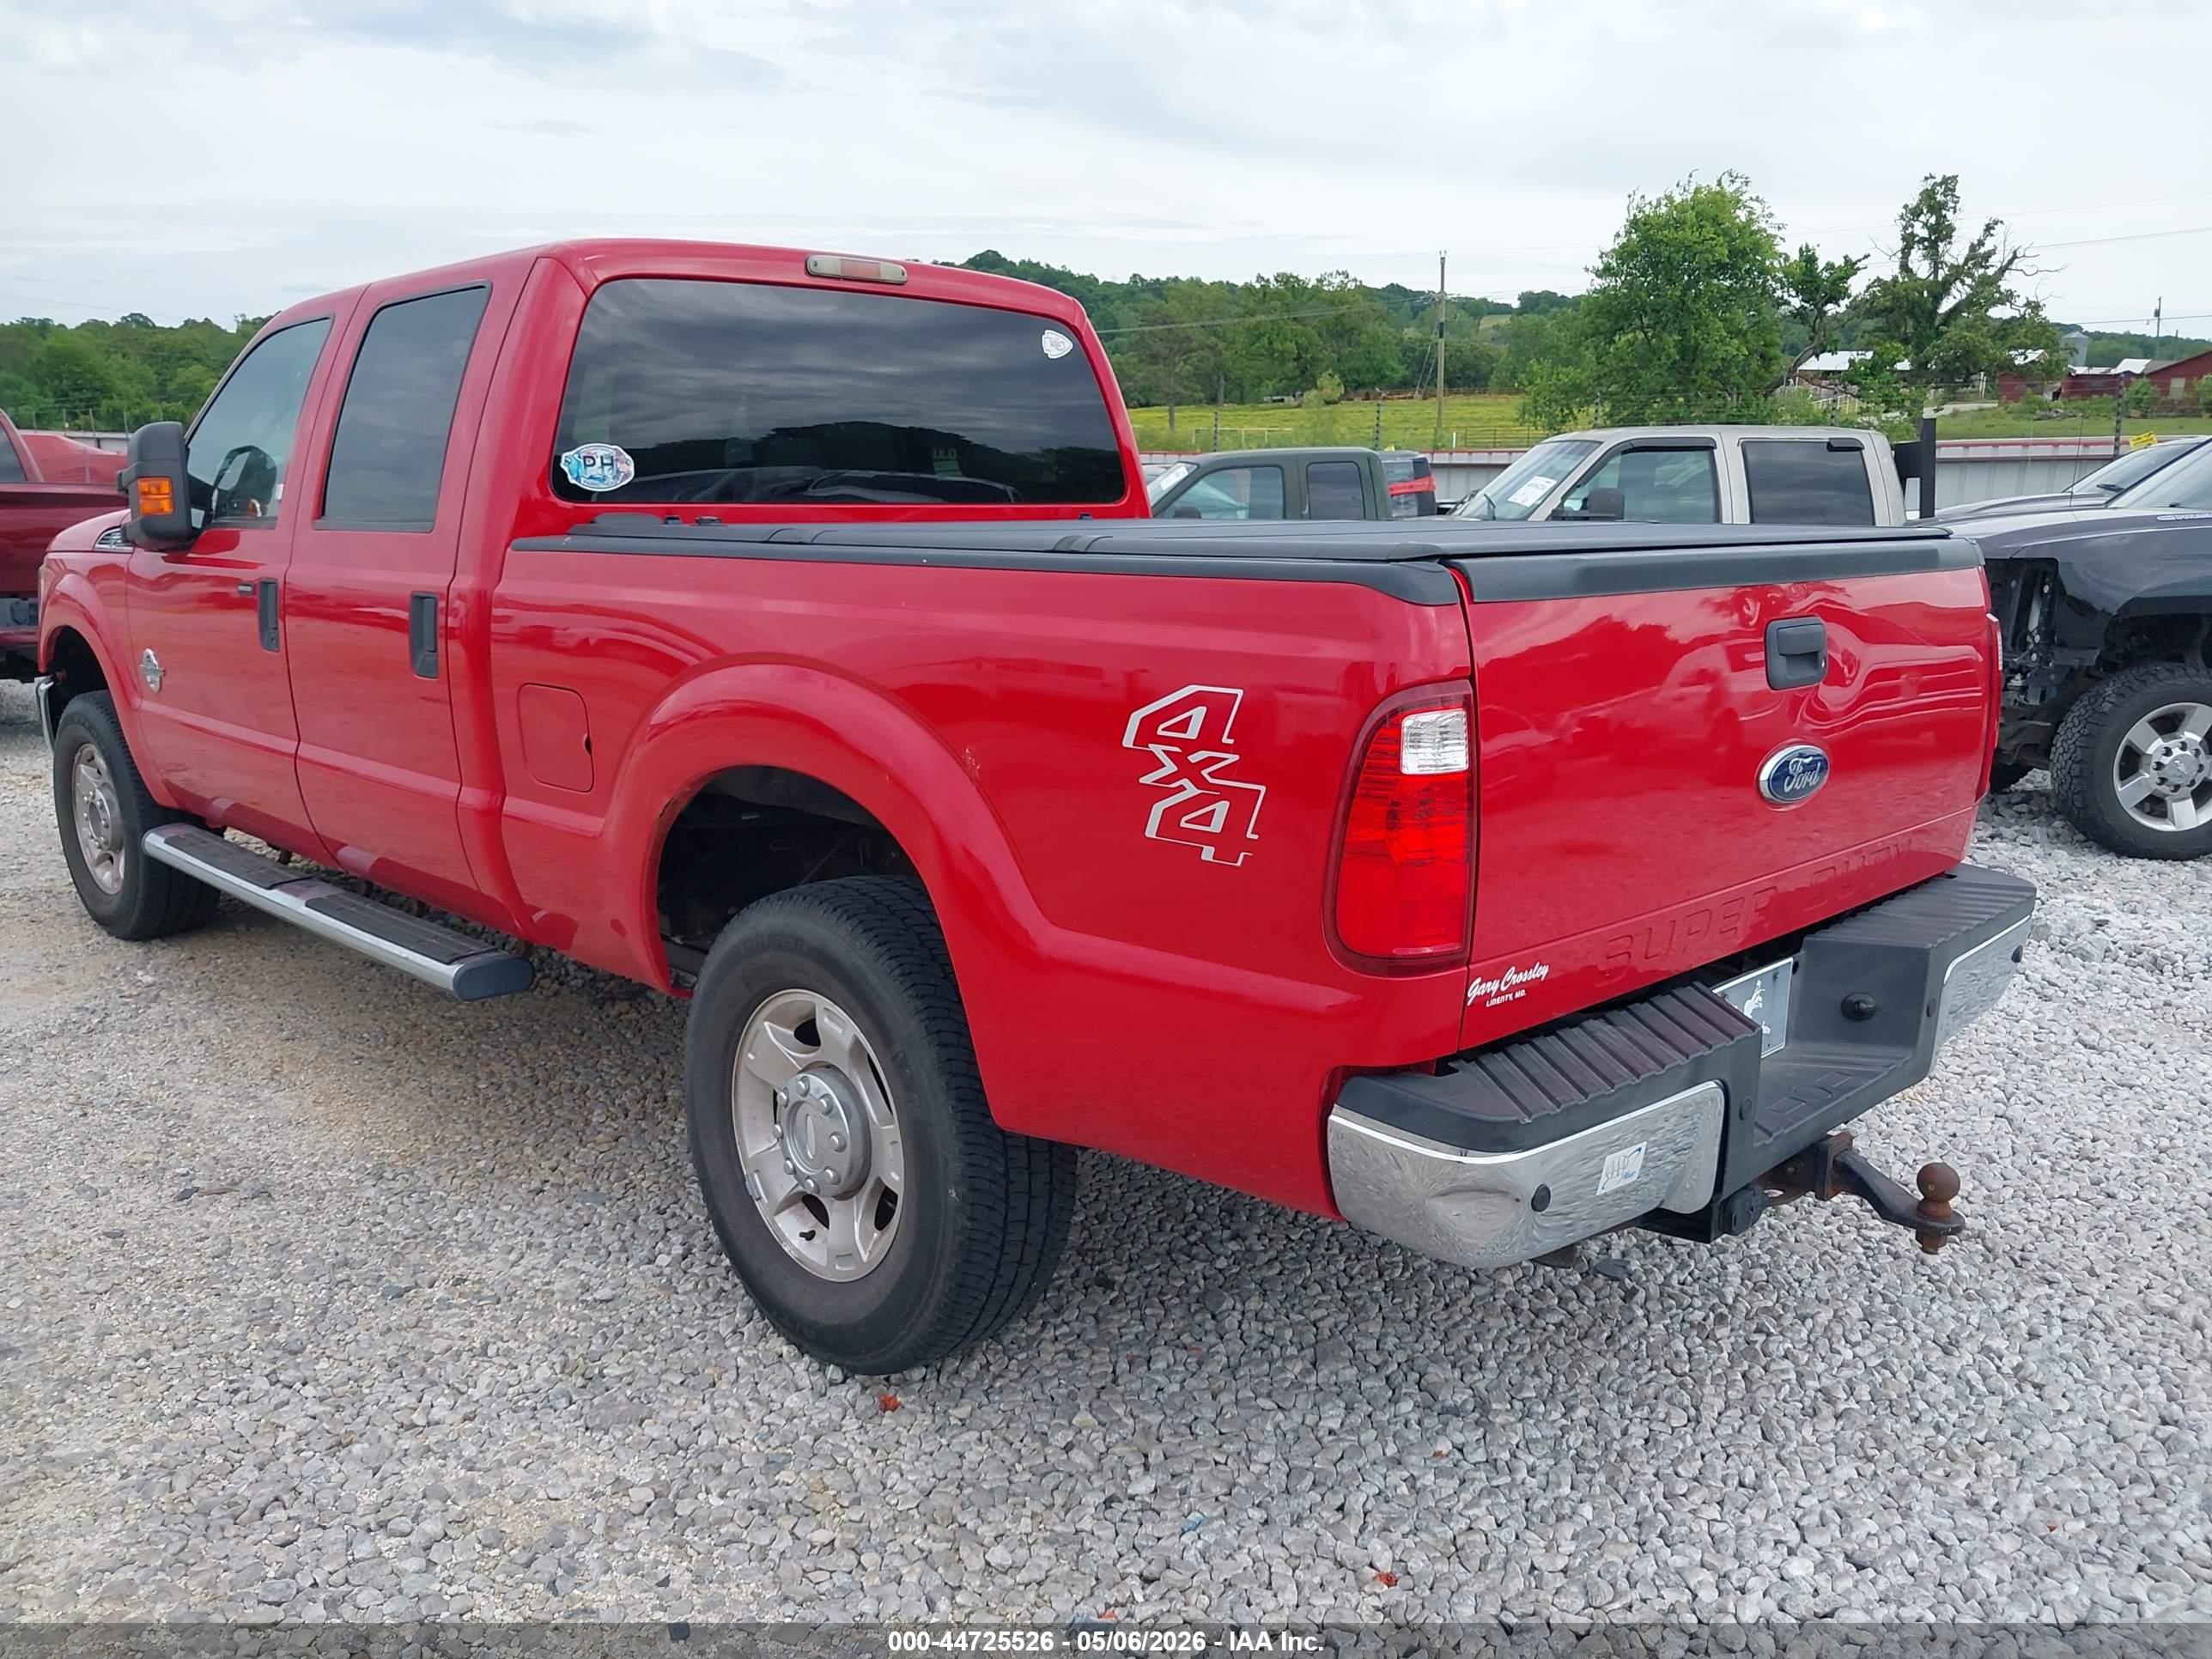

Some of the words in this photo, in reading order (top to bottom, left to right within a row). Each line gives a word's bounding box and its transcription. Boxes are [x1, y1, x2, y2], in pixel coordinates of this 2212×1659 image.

[1784, 756, 1821, 793] Ford
[1593, 885, 1778, 988] SUPER
[1467, 976, 1501, 1006] Gary
[1500, 961, 1550, 991] Crossley
